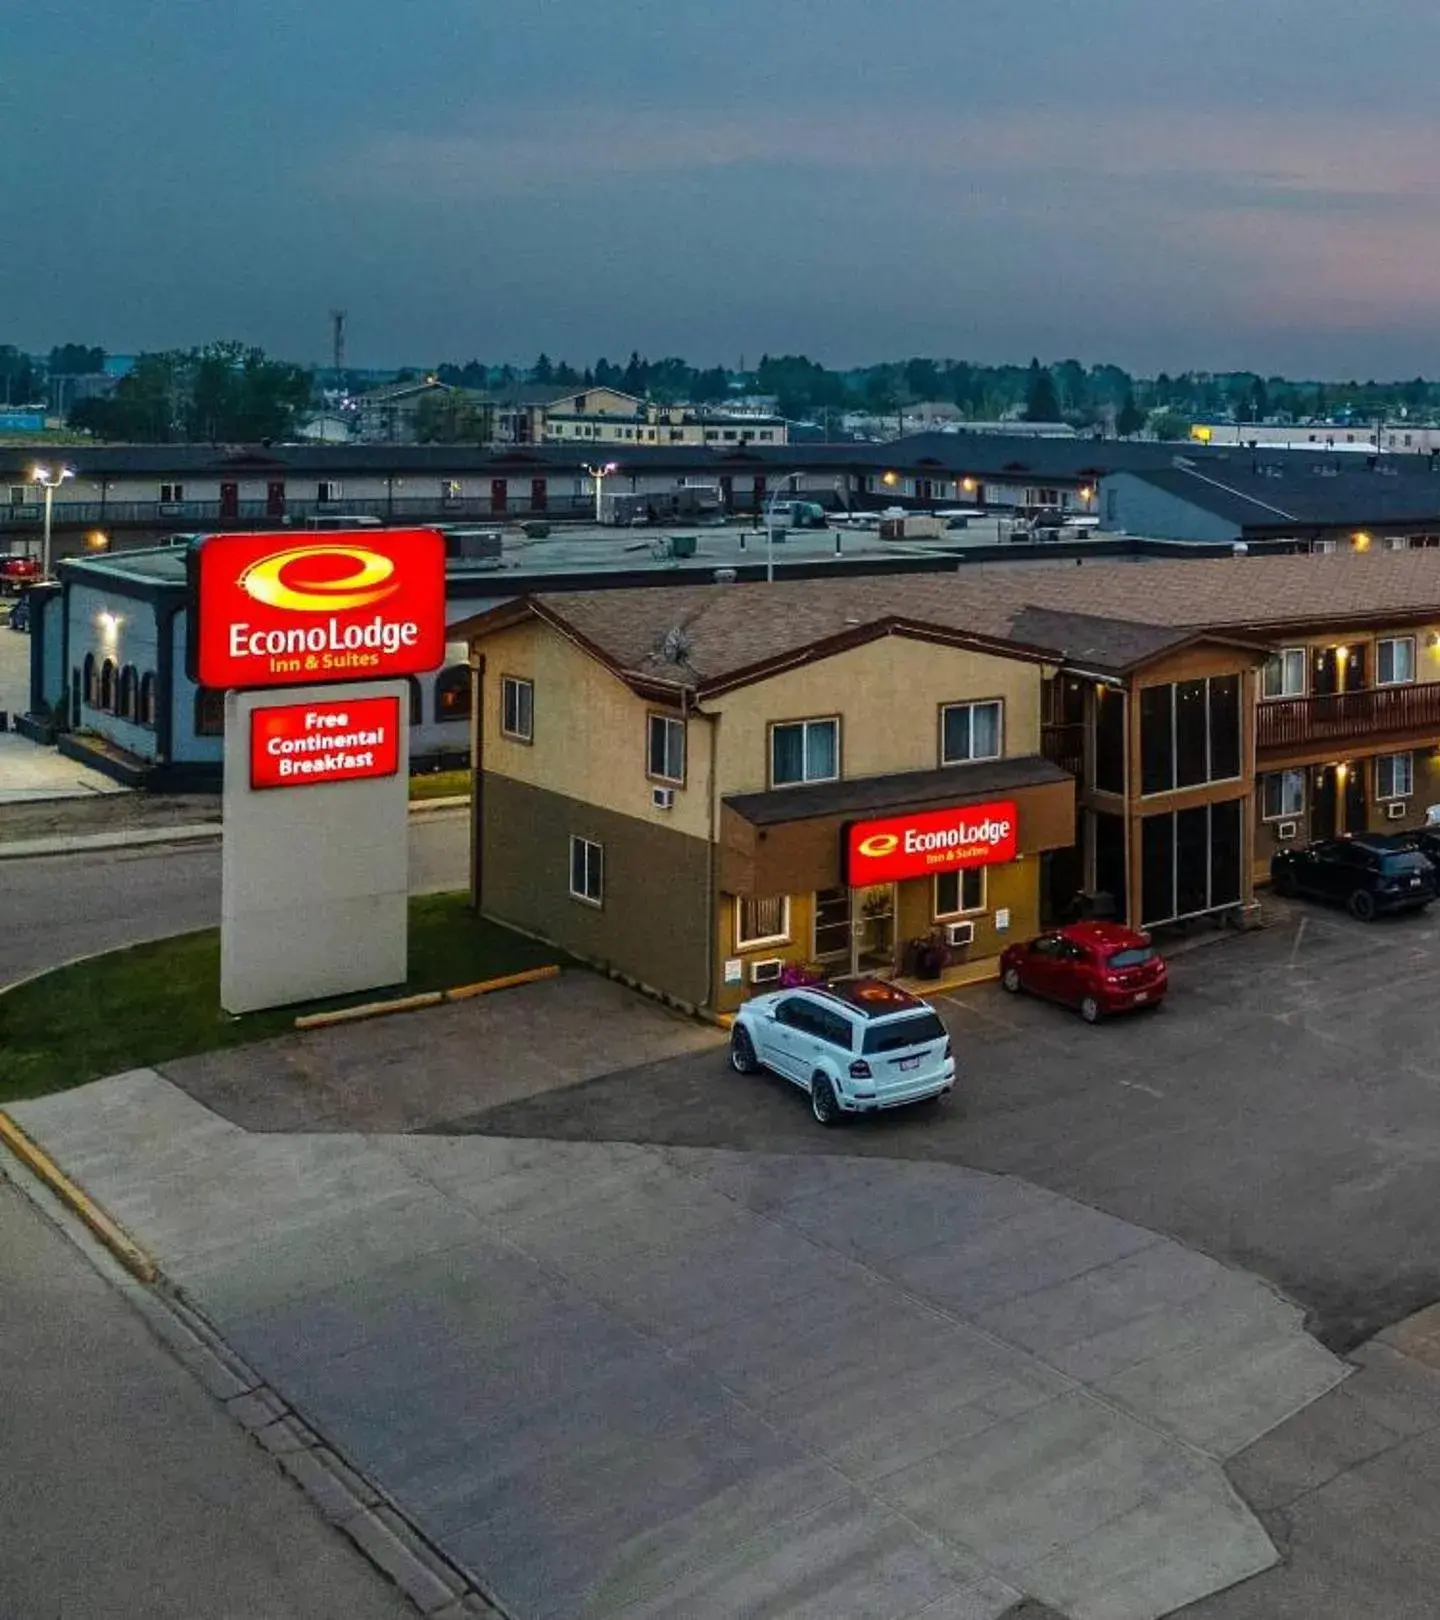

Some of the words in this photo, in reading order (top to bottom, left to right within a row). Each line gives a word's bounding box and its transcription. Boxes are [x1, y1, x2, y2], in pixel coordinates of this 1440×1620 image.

[229, 616, 418, 657] EconoLodge
[270, 657, 301, 673] Inn
[304, 656, 319, 670] &
[322, 653, 379, 669] Suites
[305, 712, 349, 730] Free
[267, 727, 385, 755] Continental
[279, 750, 374, 776] Breakfast
[905, 819, 1010, 853] EconoLodge
